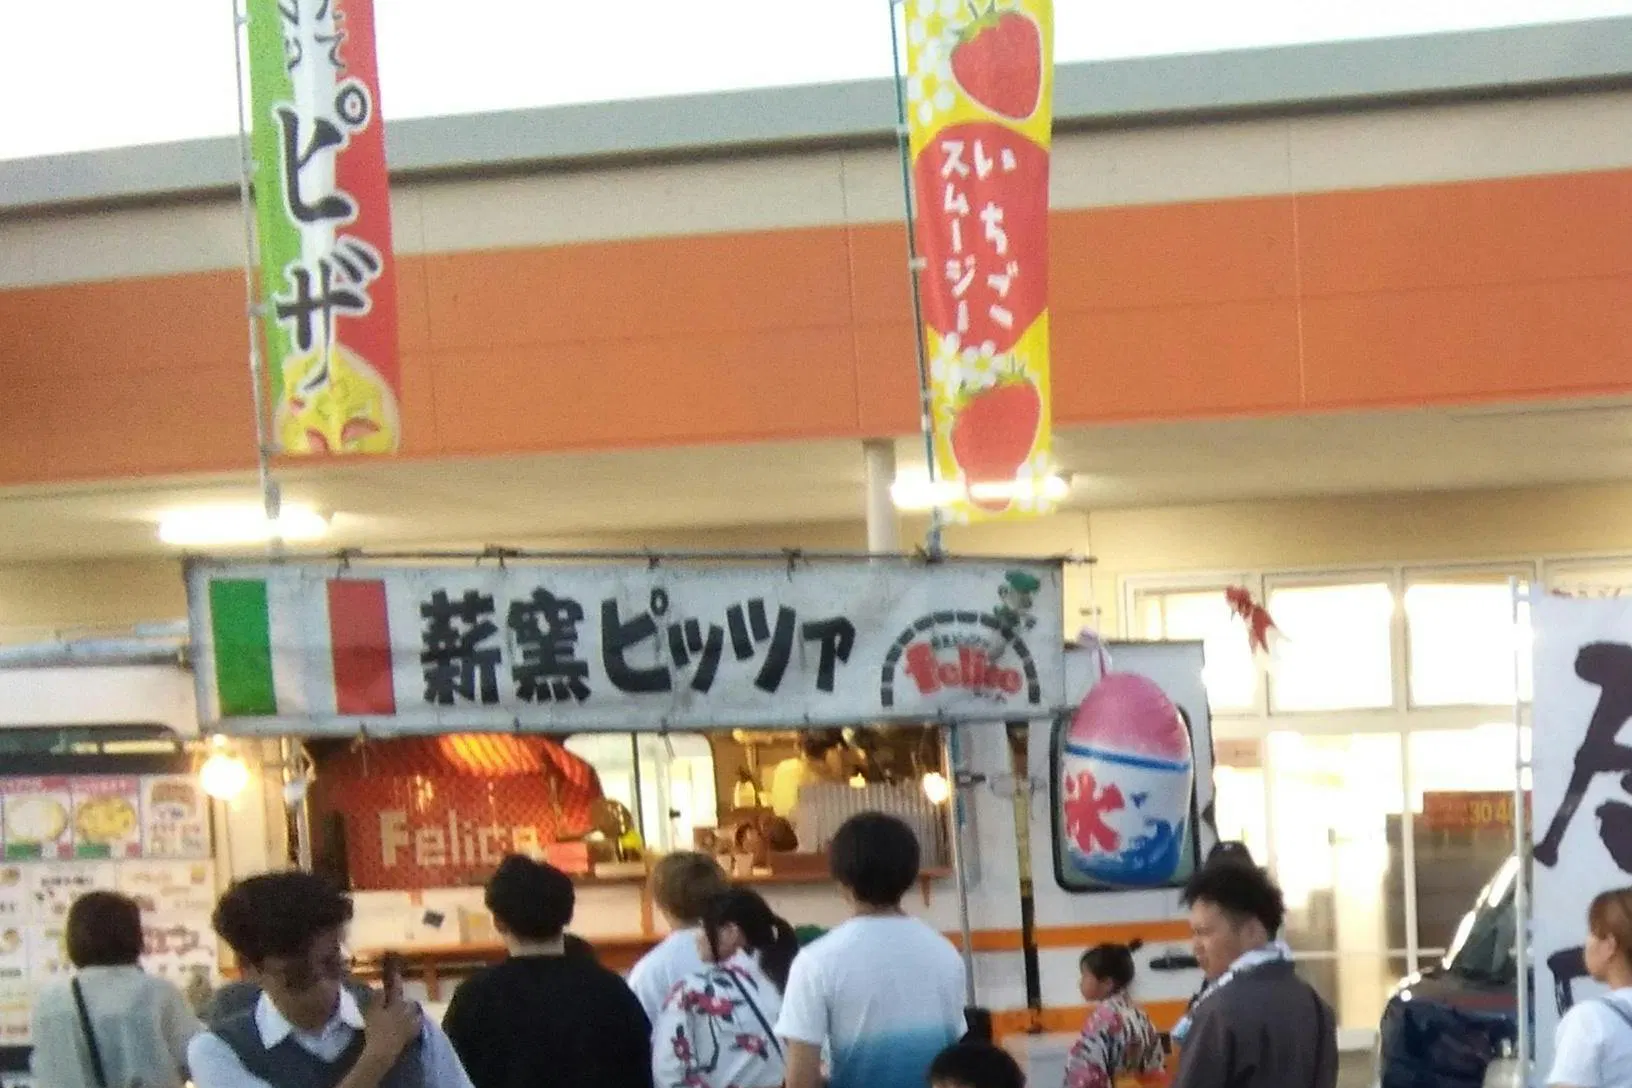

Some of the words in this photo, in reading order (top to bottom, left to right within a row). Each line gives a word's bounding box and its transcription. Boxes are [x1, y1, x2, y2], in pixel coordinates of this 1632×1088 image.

[276, 83, 378, 391] ピザ
[940, 140, 976, 334] スムージー
[973, 138, 1020, 329] いちご
[419, 585, 857, 705] 薪窯ピッツァ
[1064, 768, 1126, 856] 氷
